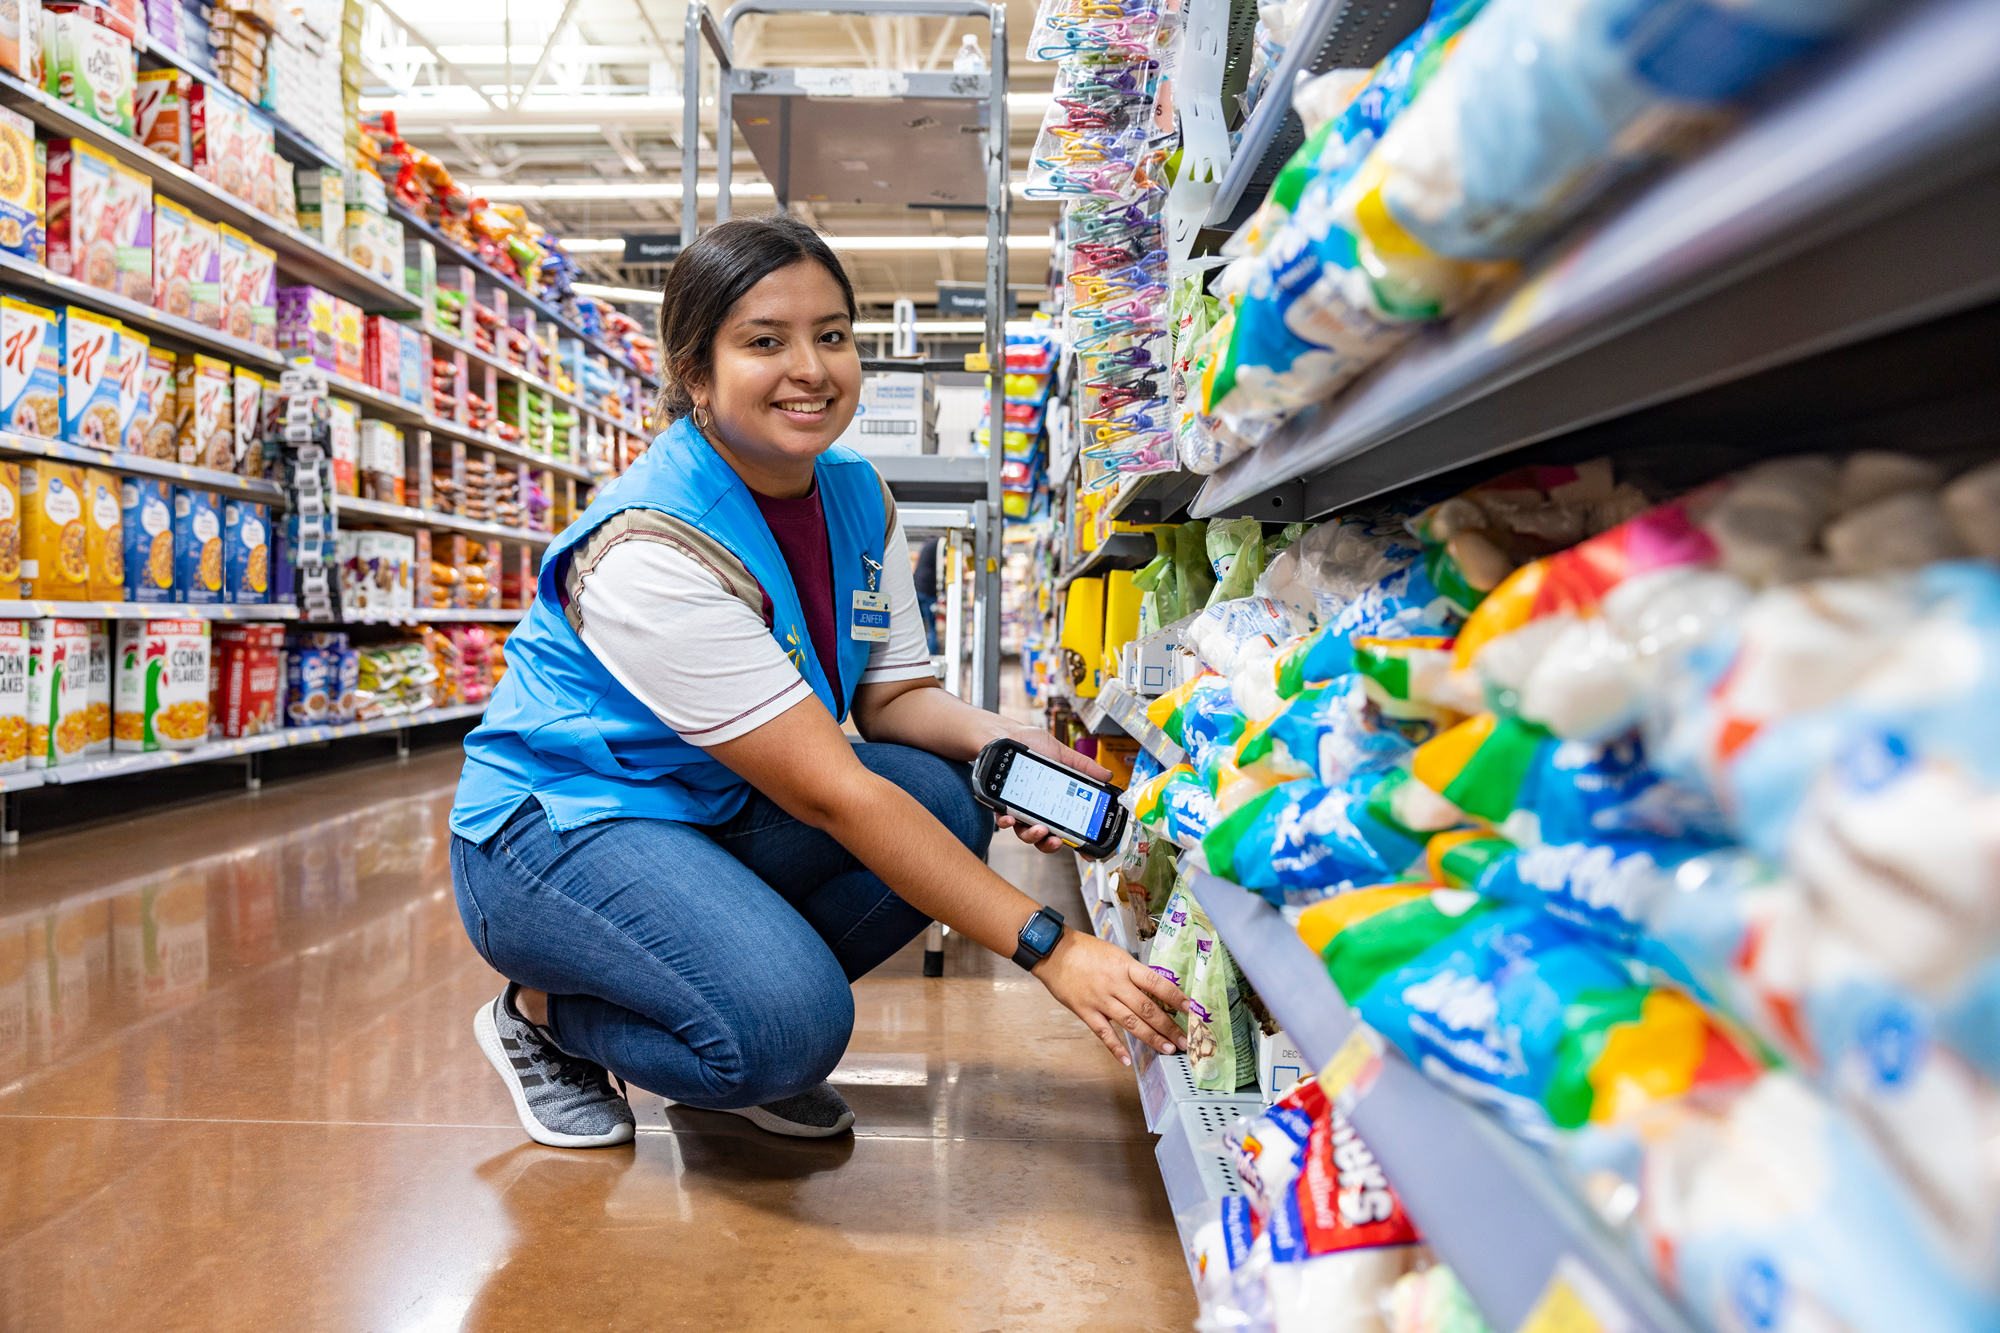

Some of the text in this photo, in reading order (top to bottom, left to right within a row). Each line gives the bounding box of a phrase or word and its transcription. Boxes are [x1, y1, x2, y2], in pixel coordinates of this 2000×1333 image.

[6, 325, 38, 376] K
[72, 335, 105, 386] K
[862, 599, 877, 607] Walmart
[860, 613, 883, 624] JENIFER
[150, 622, 200, 634] MEGA SIZE
[171, 650, 205, 667] CORN
[171, 669, 205, 682] FLAKES
[1282, 1049, 1298, 1059] DEC
